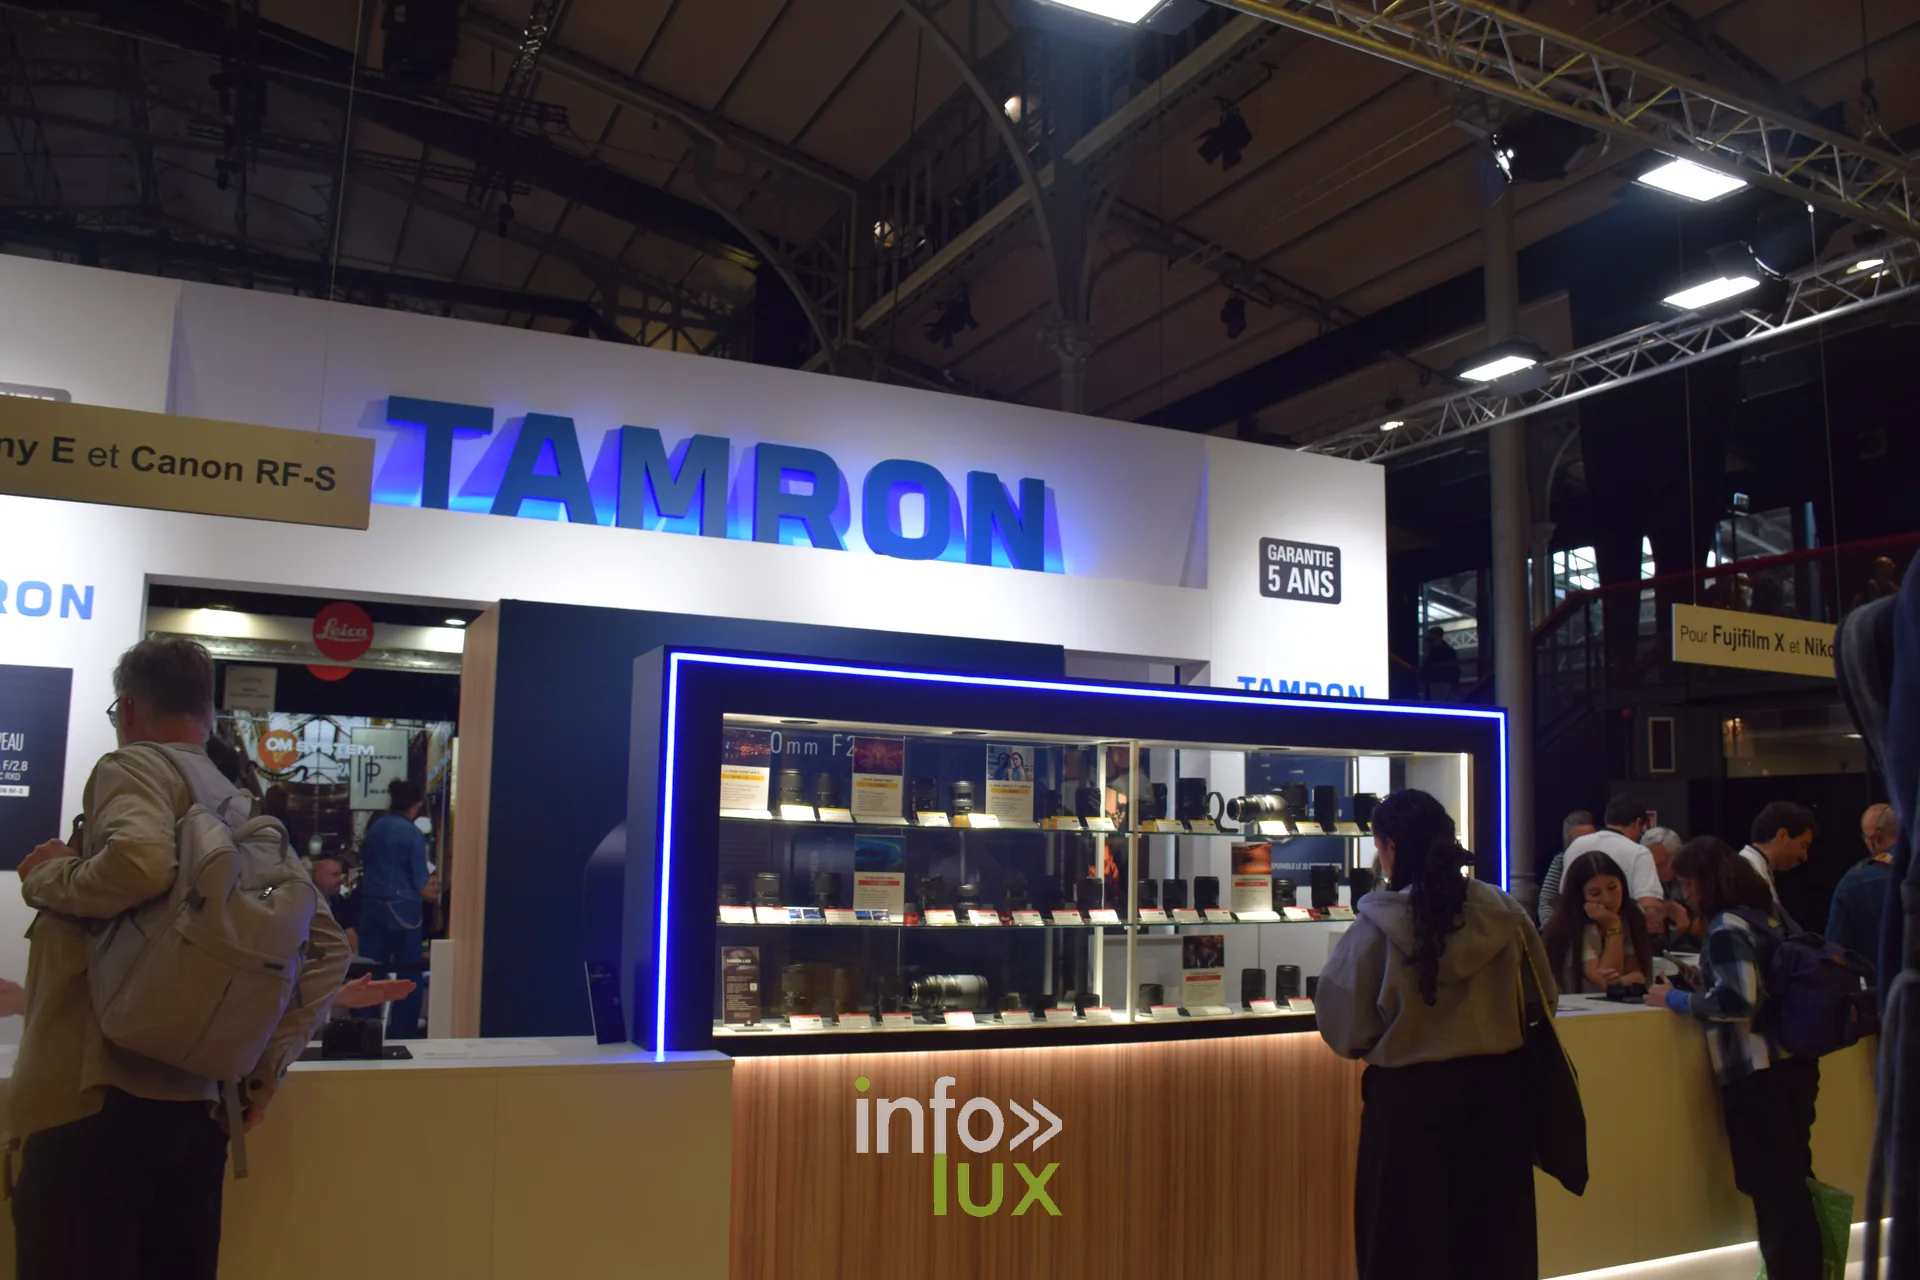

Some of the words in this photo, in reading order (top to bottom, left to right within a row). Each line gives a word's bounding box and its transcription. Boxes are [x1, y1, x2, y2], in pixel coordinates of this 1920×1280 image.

[52, 436, 76, 464] E
[88, 443, 119, 468] et
[131, 445, 243, 482] Canon
[256, 458, 336, 491] RF-S
[387, 395, 1045, 572] TAMRON
[1267, 544, 1334, 568] GARANTIE
[1268, 564, 1281, 592] 5
[1287, 567, 1335, 598] ANS
[0, 578, 95, 620] ON
[315, 617, 368, 641] Leica
[1680, 625, 1708, 643] Pour
[1713, 625, 1770, 651] Fujifilm
[1774, 632, 1785, 652] X
[1789, 638, 1800, 654] et
[0, 732, 24, 751] EAU
[265, 737, 293, 751] OM
